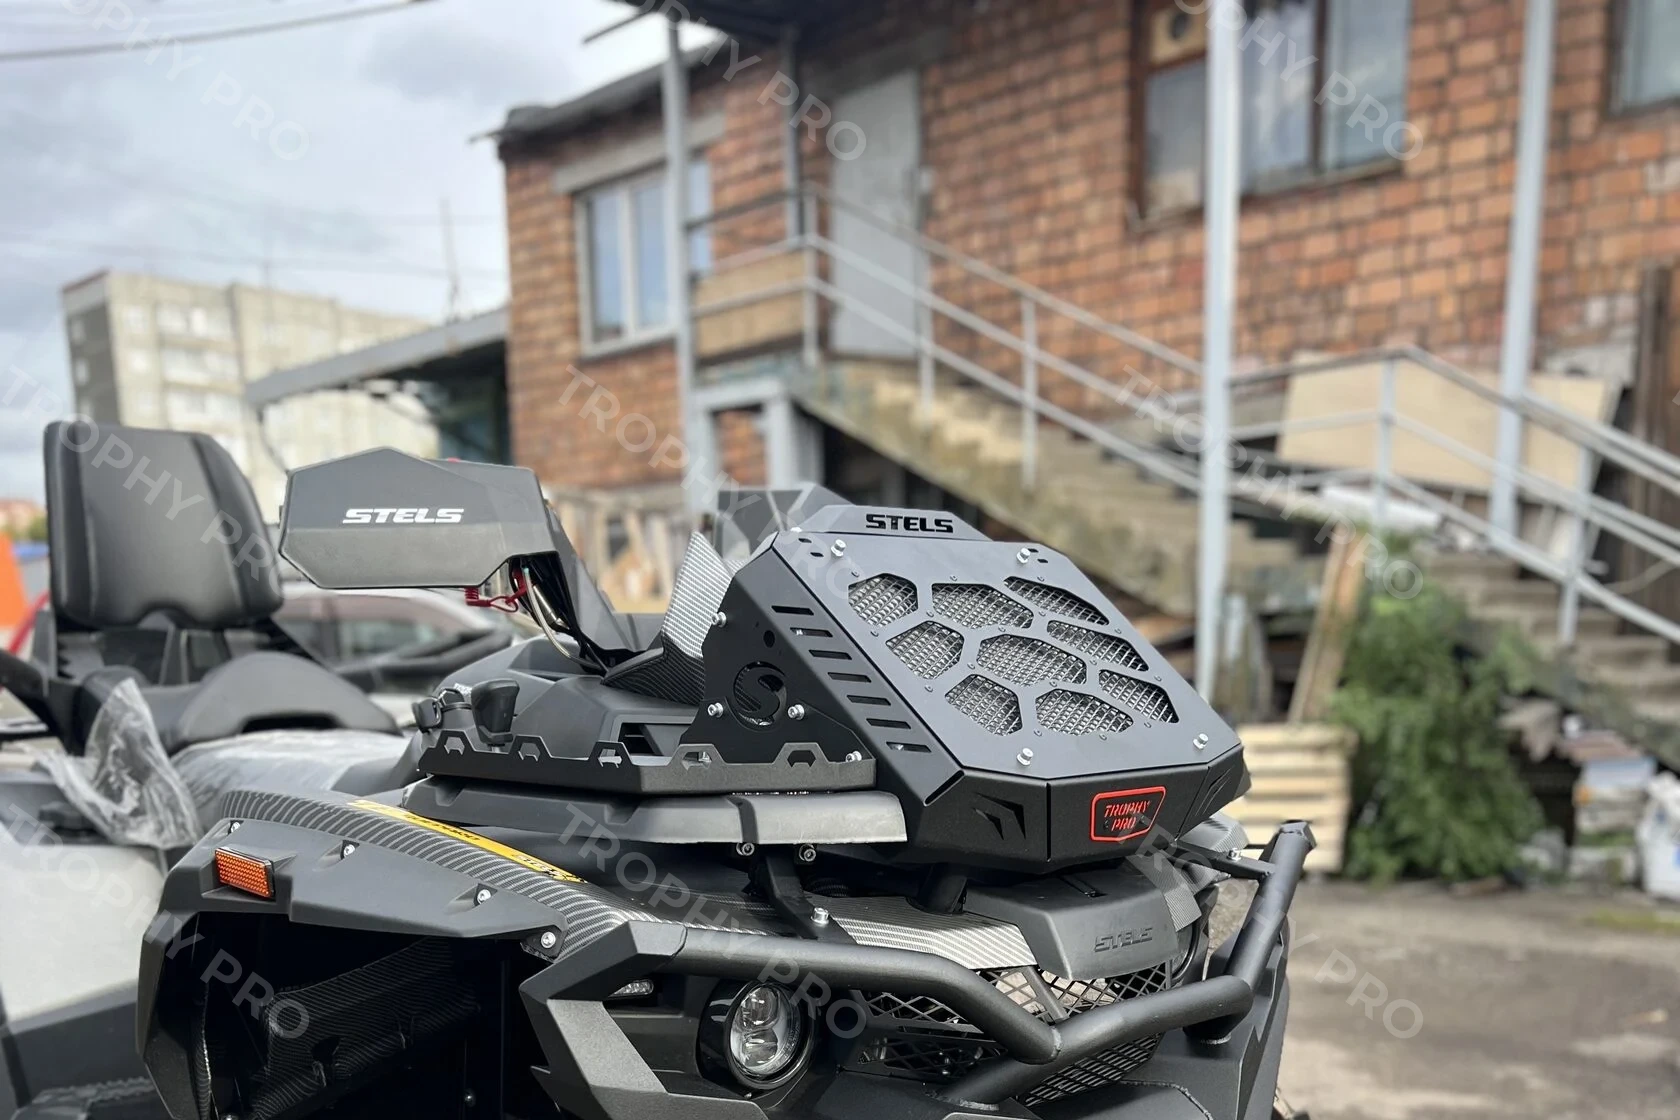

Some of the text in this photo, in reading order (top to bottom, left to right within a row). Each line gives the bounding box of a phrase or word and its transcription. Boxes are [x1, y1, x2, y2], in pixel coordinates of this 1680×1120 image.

[342, 508, 464, 524] STELS
[866, 514, 953, 533] STELS
[1104, 801, 1151, 818] TROPHY
[1111, 817, 1137, 831] PRO
[1093, 928, 1153, 953] STELS
